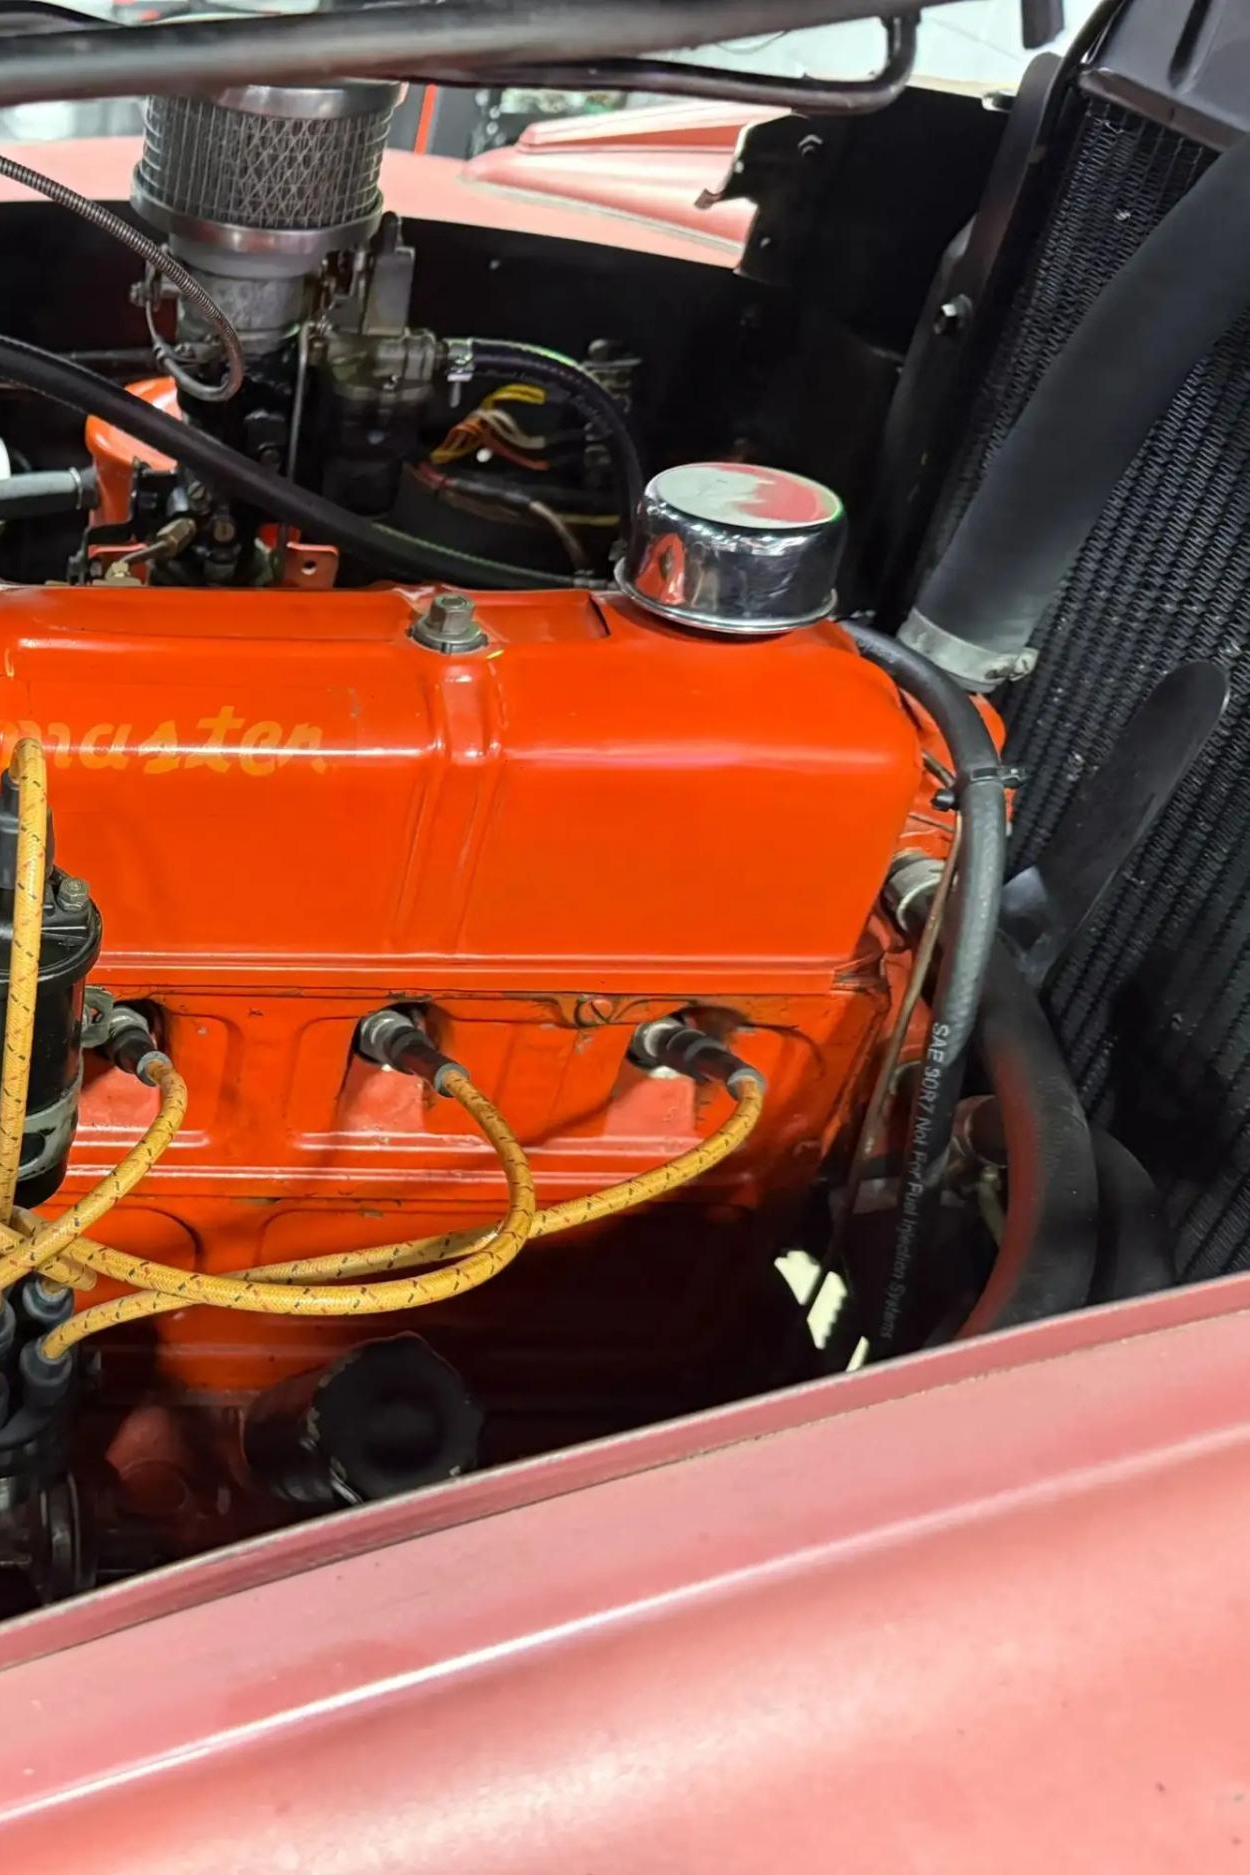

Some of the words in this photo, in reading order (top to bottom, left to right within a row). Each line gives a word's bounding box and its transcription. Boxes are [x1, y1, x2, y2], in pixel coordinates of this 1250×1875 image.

[927, 1022, 950, 1063] SAE
[912, 1117, 932, 1147] Not
[908, 1151, 928, 1181] For
[903, 1182, 924, 1220] Fuel
[891, 1219, 918, 1280] Injection
[879, 1283, 906, 1339] Systems
